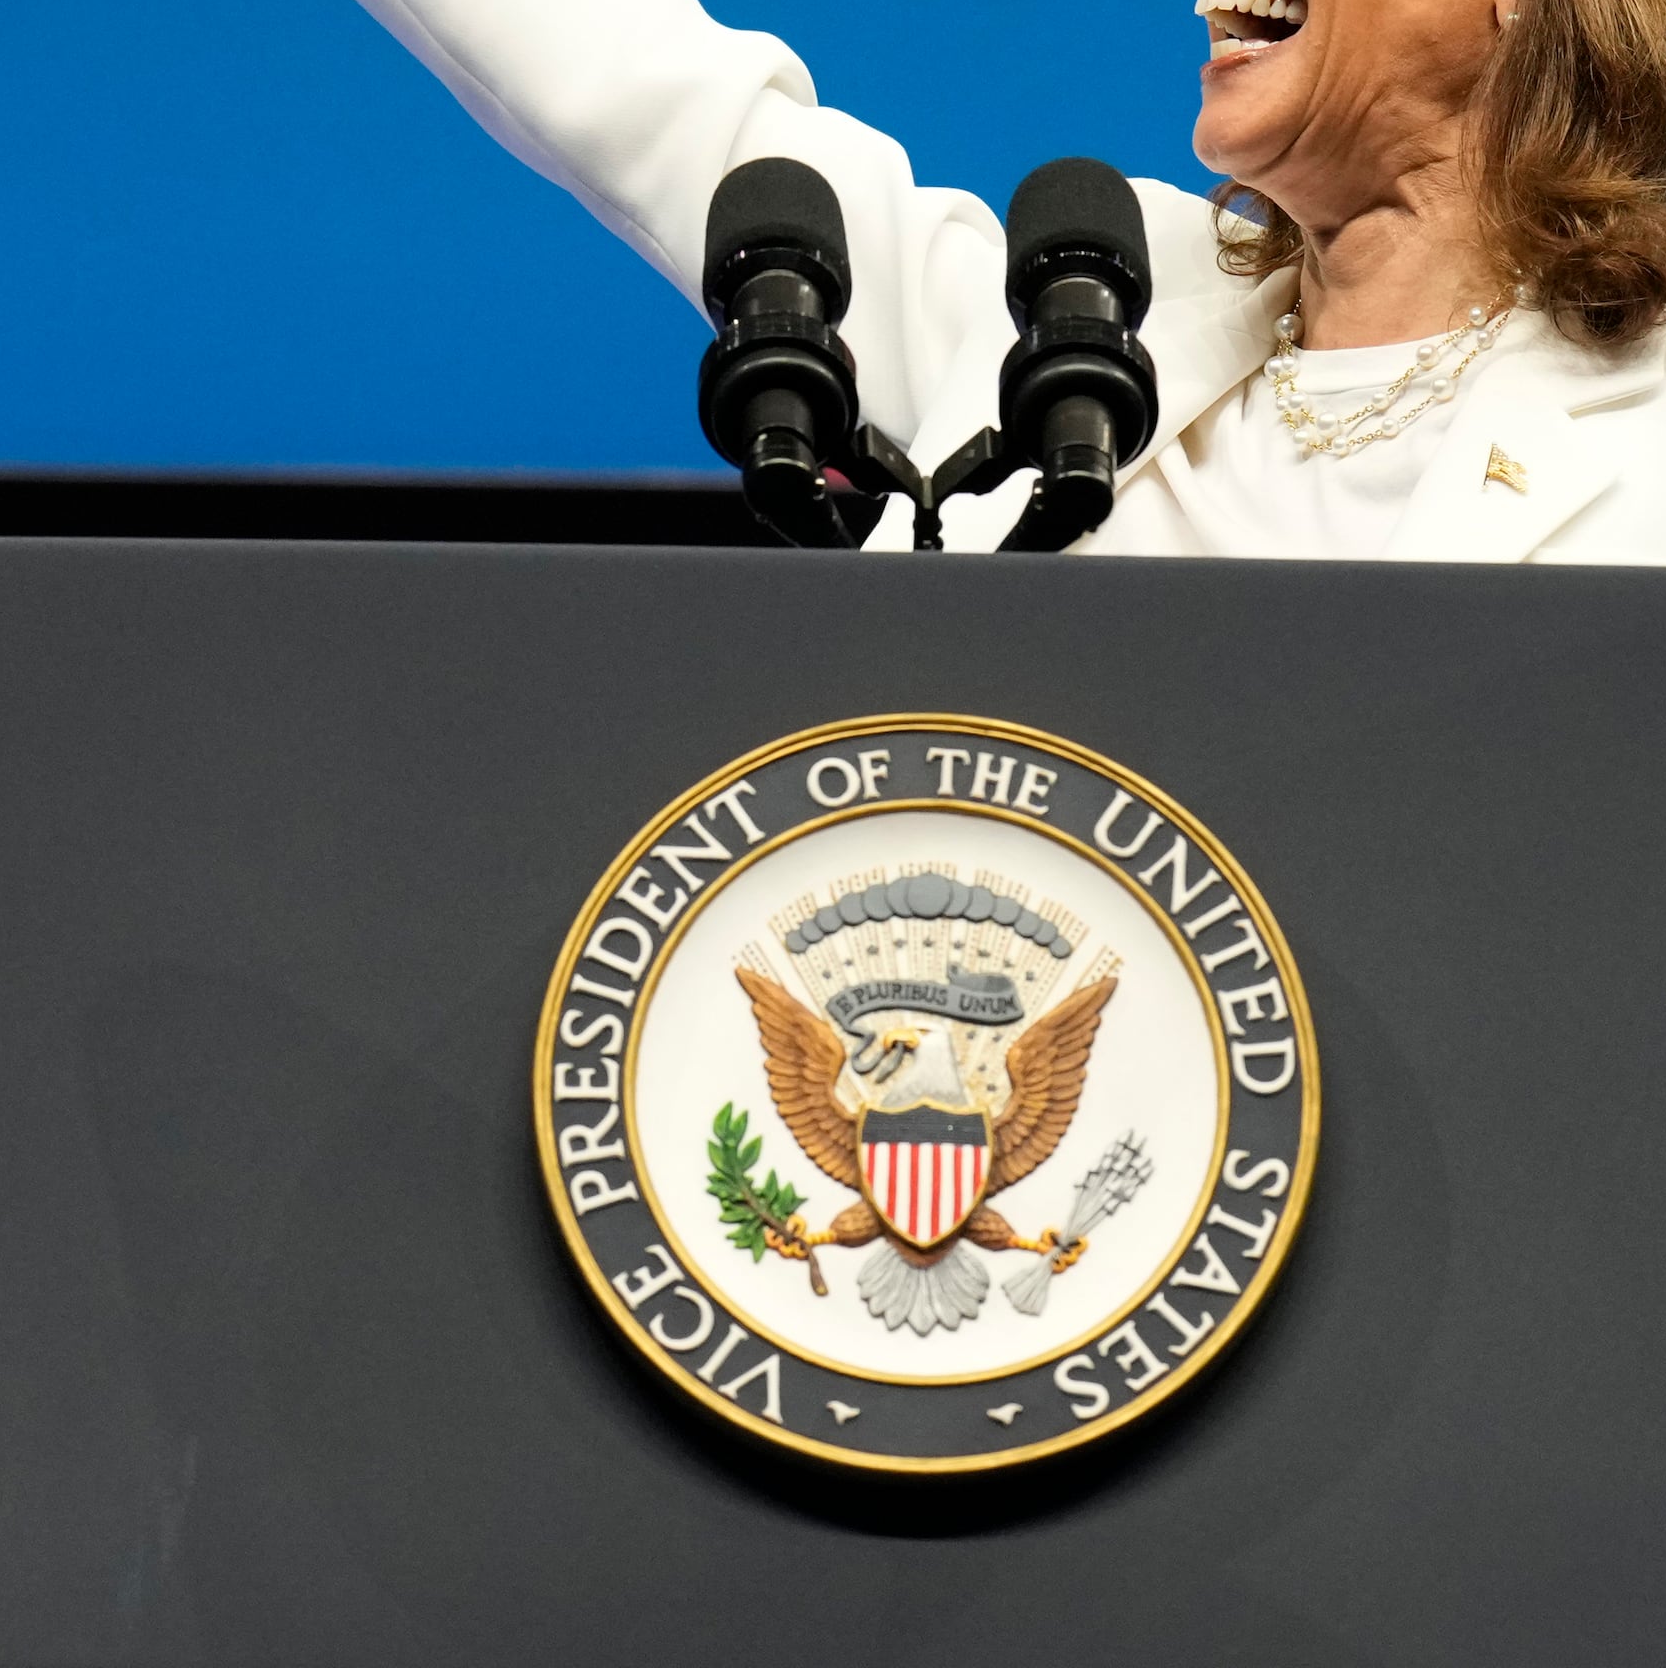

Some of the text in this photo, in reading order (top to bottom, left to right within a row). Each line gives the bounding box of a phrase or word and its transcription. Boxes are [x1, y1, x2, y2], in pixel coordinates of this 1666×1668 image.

[554, 746, 1297, 1425] VICE PRESIDENT OF THE UNITED STATES
[835, 982, 1018, 1016] E PLURIBUS UNUM
